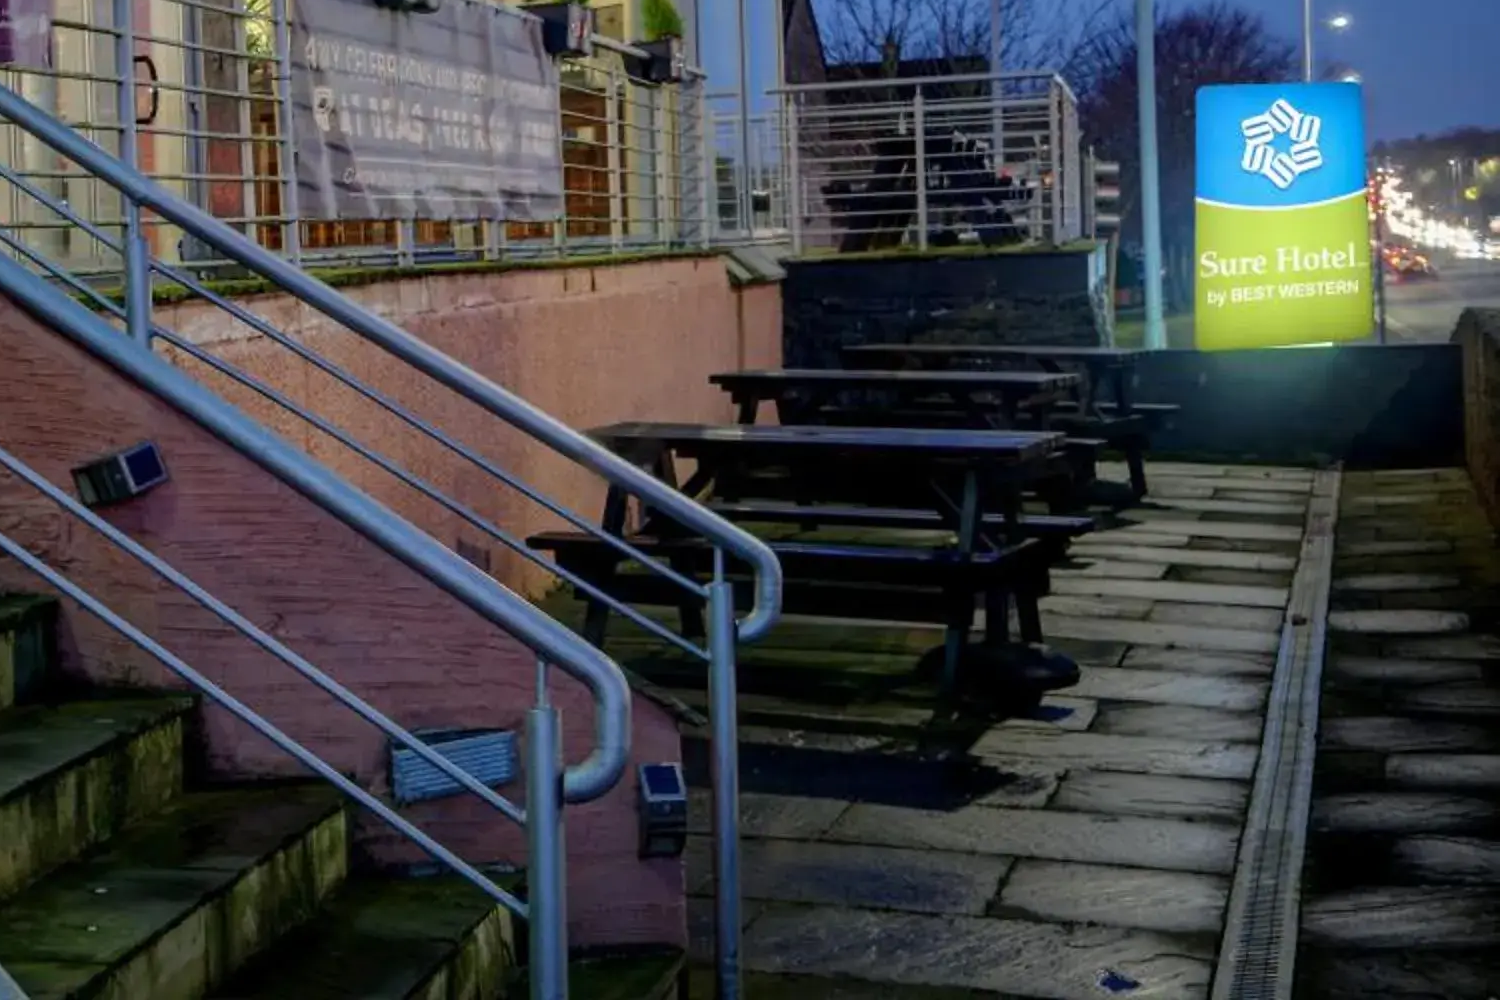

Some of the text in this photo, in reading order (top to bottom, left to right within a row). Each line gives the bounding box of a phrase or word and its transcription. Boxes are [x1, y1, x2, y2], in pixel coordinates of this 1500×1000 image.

[1200, 242, 1356, 278] Sure Hotel
[1207, 280, 1359, 308] by BEST WESTERN
